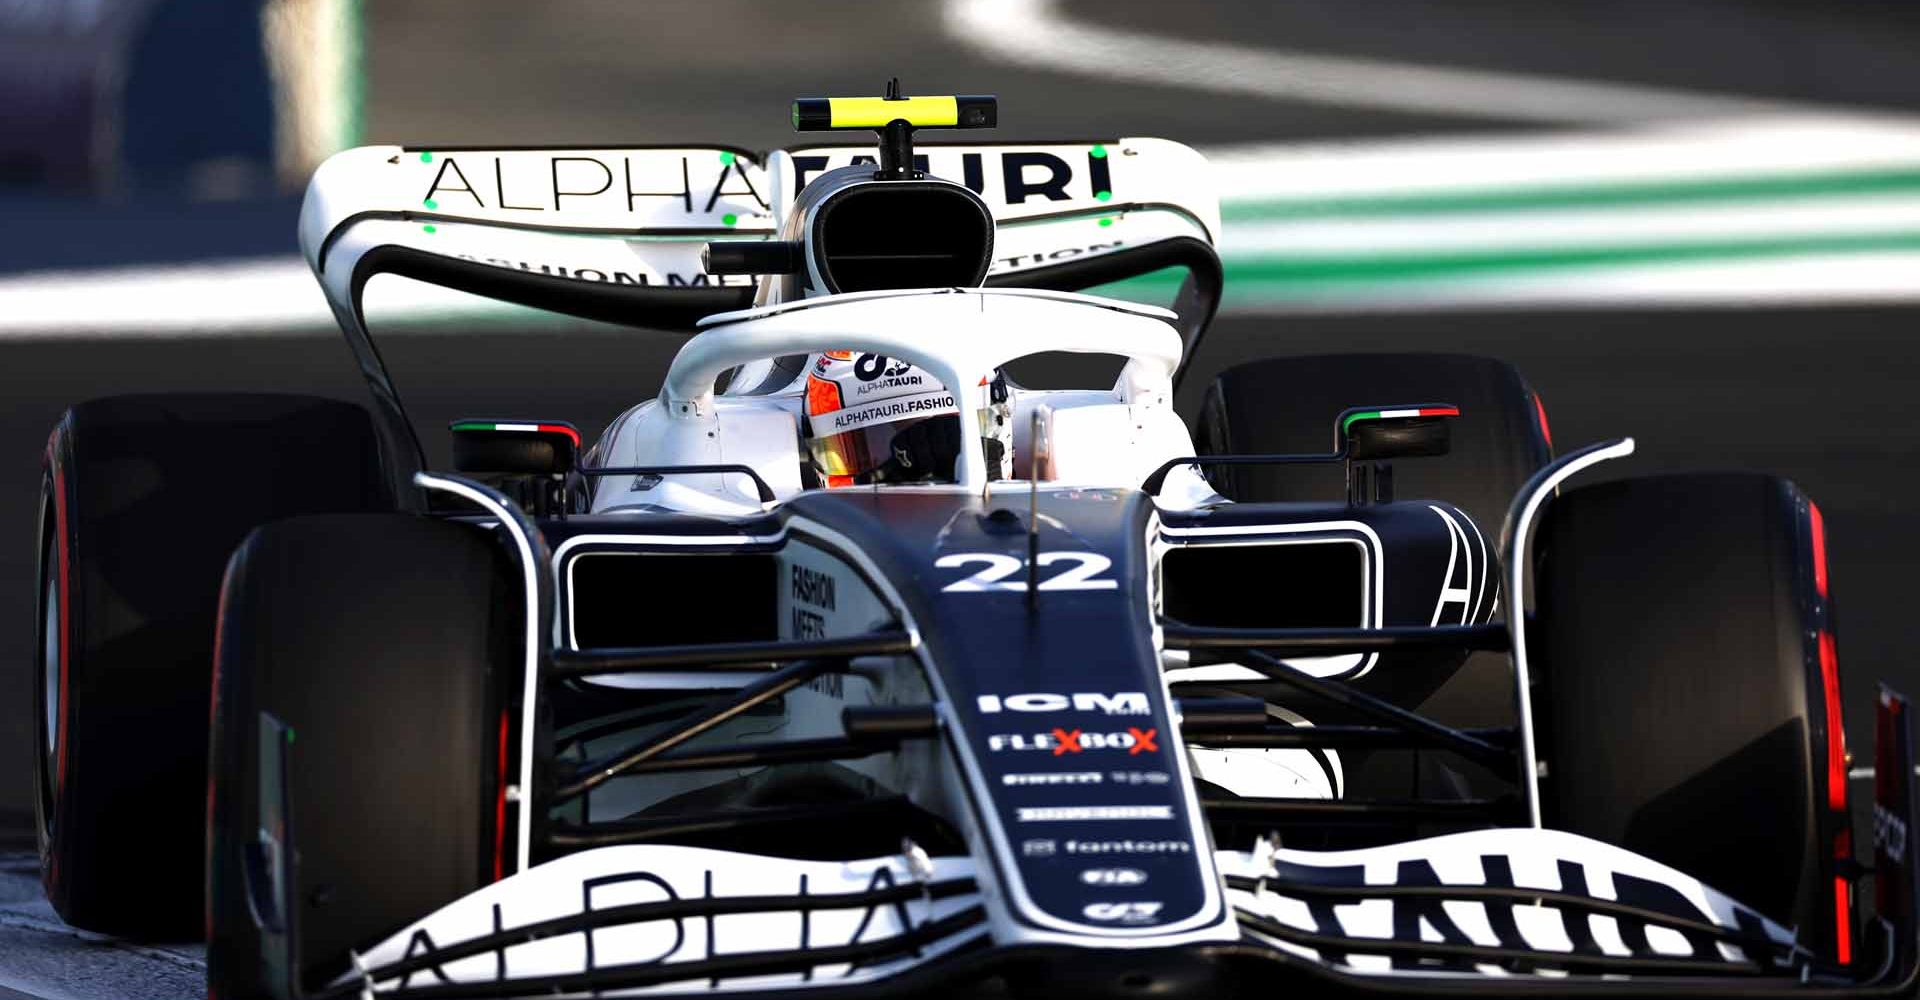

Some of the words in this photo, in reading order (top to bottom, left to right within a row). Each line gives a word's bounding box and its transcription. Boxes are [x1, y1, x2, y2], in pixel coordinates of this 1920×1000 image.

[857, 376, 922, 396] ALPHATAURI
[934, 552, 1119, 592] 22
[977, 692, 1151, 713] ICM
[988, 727, 1158, 756] FLEXBOX
[1066, 839, 1190, 853] fantom
